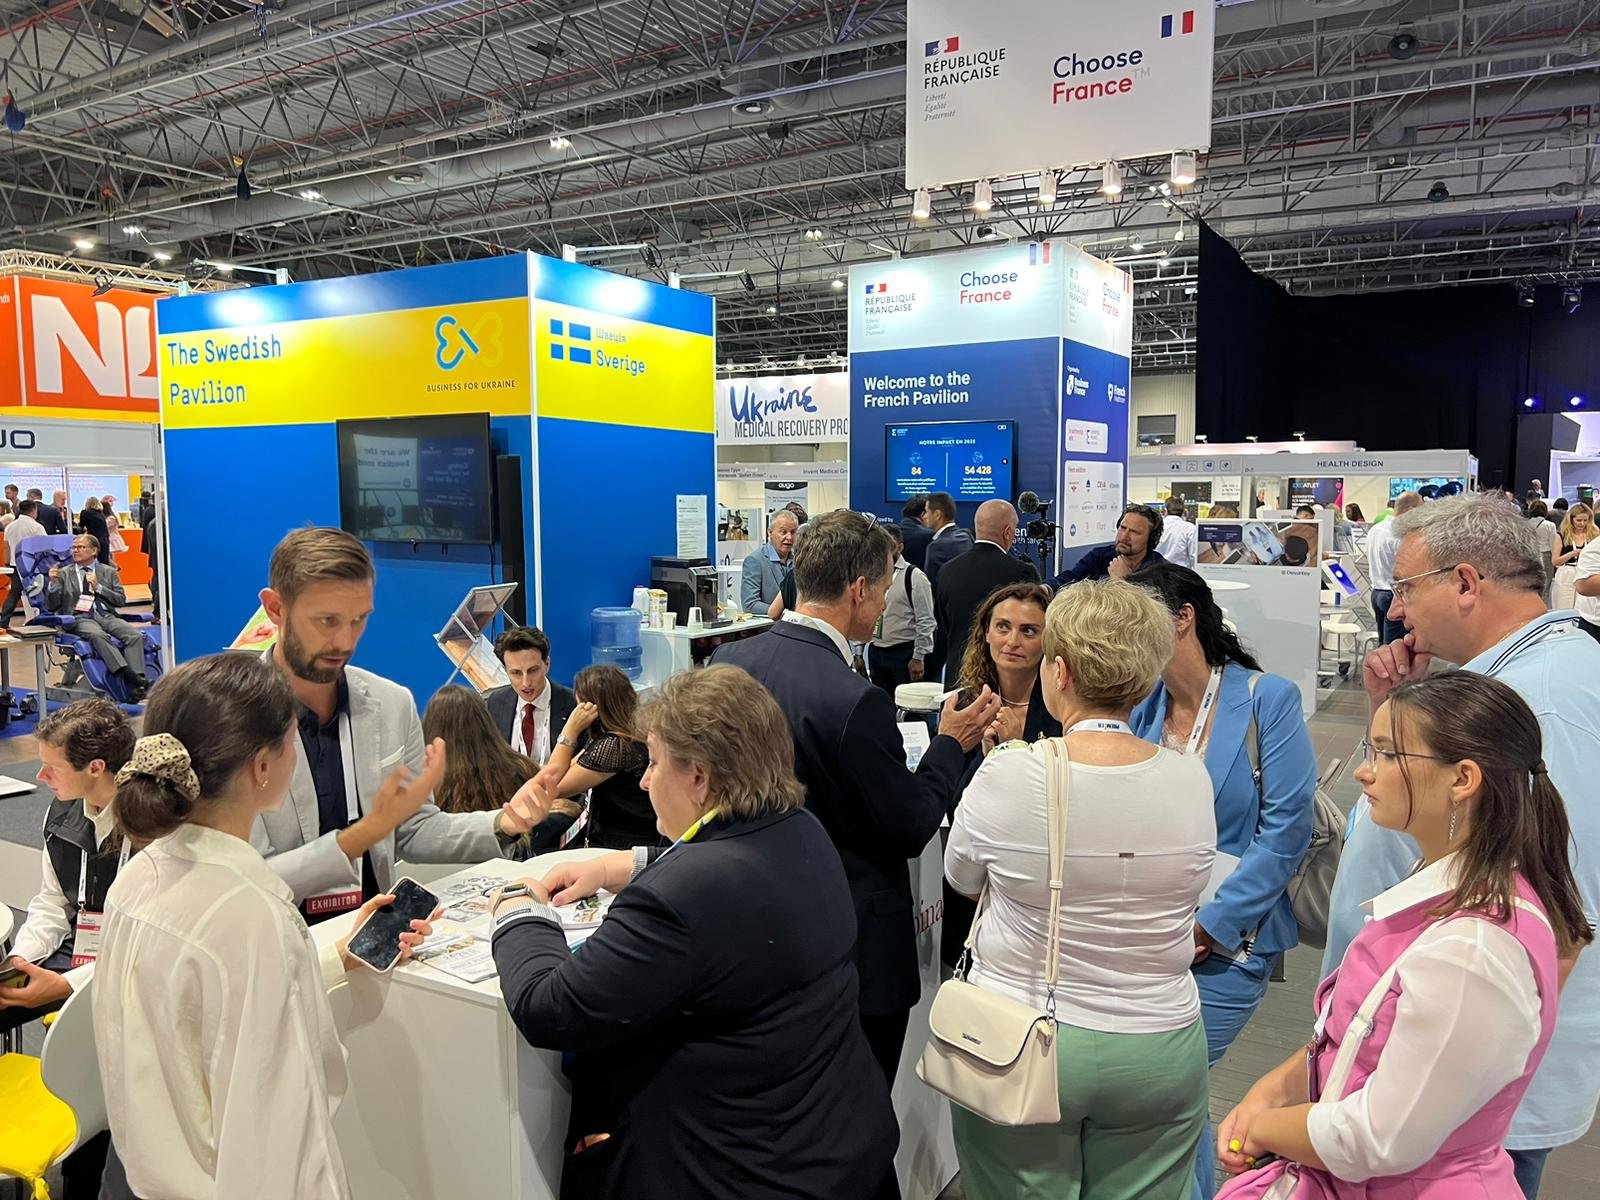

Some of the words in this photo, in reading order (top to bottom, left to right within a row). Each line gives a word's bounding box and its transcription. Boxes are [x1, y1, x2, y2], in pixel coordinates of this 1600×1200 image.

[924, 48, 1006, 75] RÉPUBLIQUE
[1053, 50, 1143, 78] Choose
[924, 64, 1000, 89] FRANÇAISE
[1053, 78, 1133, 104] France
[960, 271, 1018, 287] Choose
[960, 290, 1012, 304] France
[168, 342, 199, 366] The
[205, 333, 281, 362] Swedish
[596, 349, 645, 376] Sverige
[170, 380, 246, 406] Pavilion
[426, 383, 462, 393] BUSINESS
[464, 382, 479, 391] FOR
[481, 379, 517, 389] UKRAINE
[864, 375, 926, 391] Welcome
[929, 374, 944, 387] to
[947, 370, 971, 386] the
[730, 385, 818, 424] Ukraine
[864, 391, 910, 408] French
[913, 389, 969, 405] Pavilion
[734, 420, 776, 438] MEDICAL
[778, 419, 828, 437] RECOVERY
[311, 895, 357, 910] EXHIBITOR
